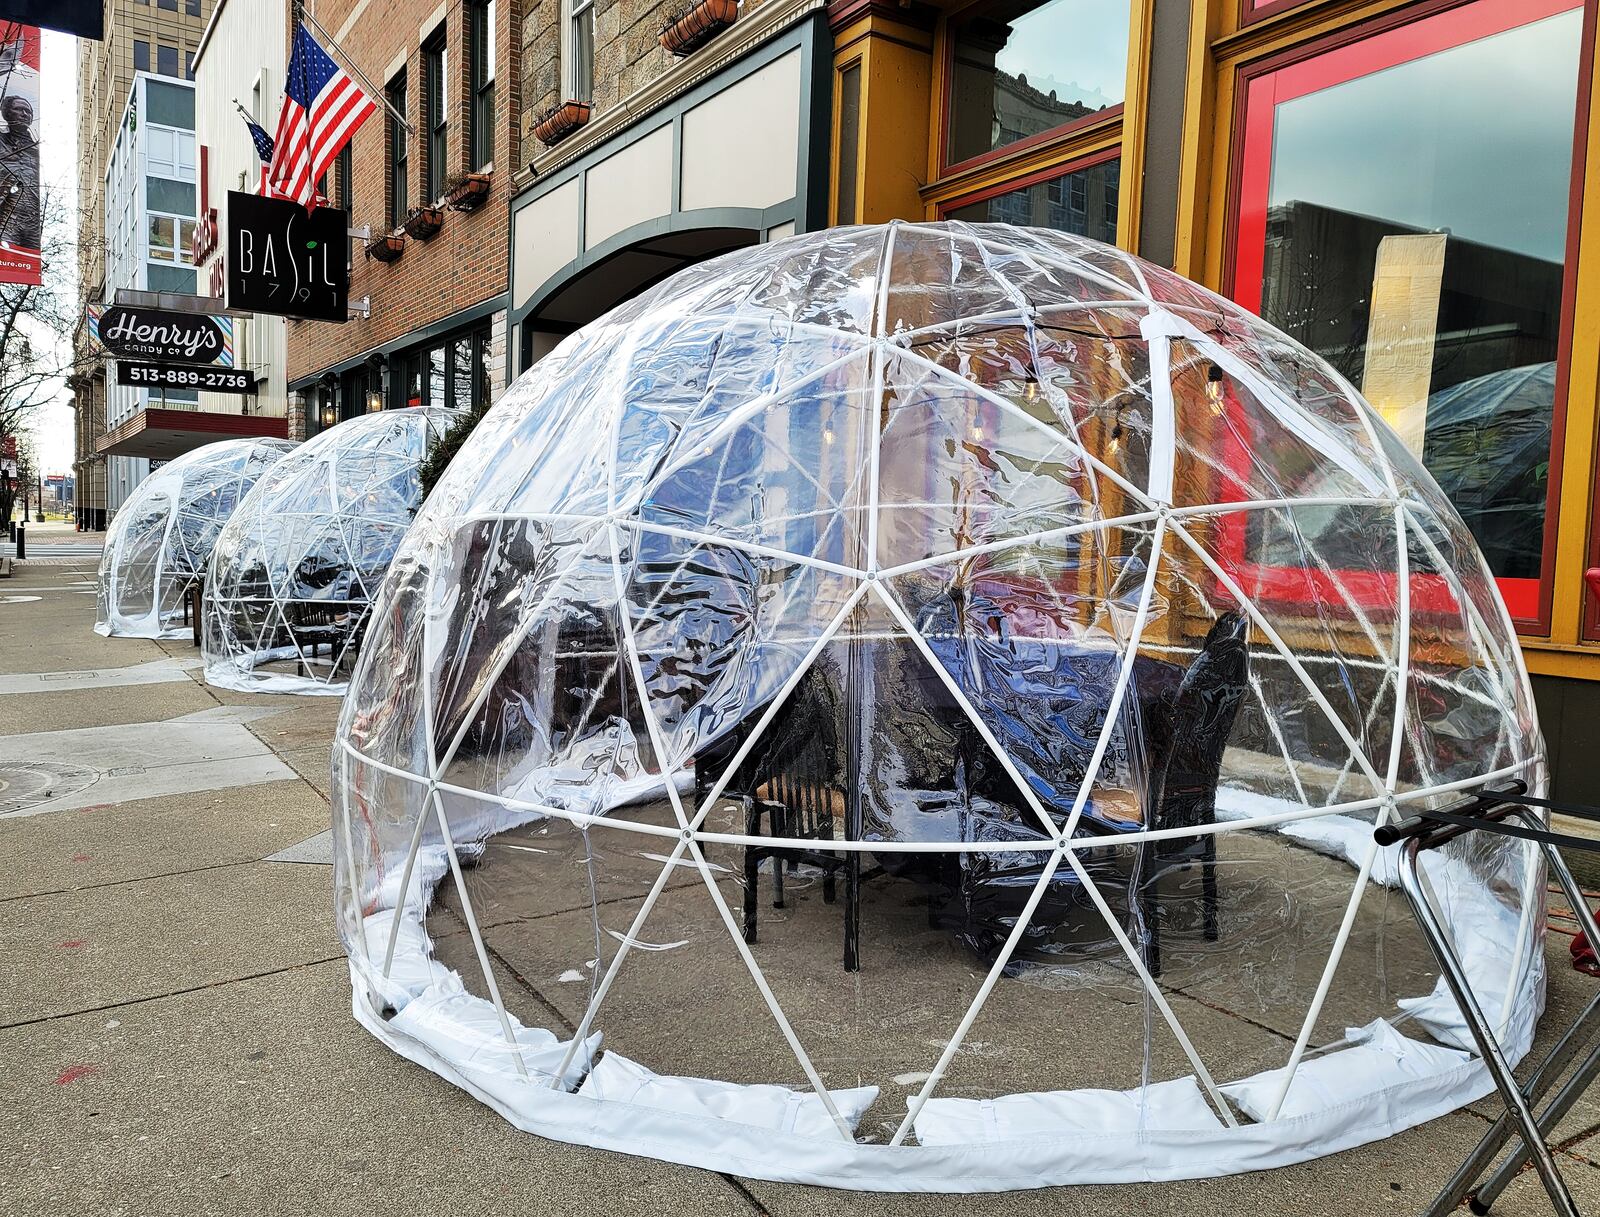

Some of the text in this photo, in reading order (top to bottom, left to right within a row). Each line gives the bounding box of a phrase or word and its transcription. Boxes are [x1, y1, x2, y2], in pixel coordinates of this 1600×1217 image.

[241, 279, 337, 307] 1791
[106, 312, 217, 357] Henry's
[130, 367, 247, 388] 513-889-2736
